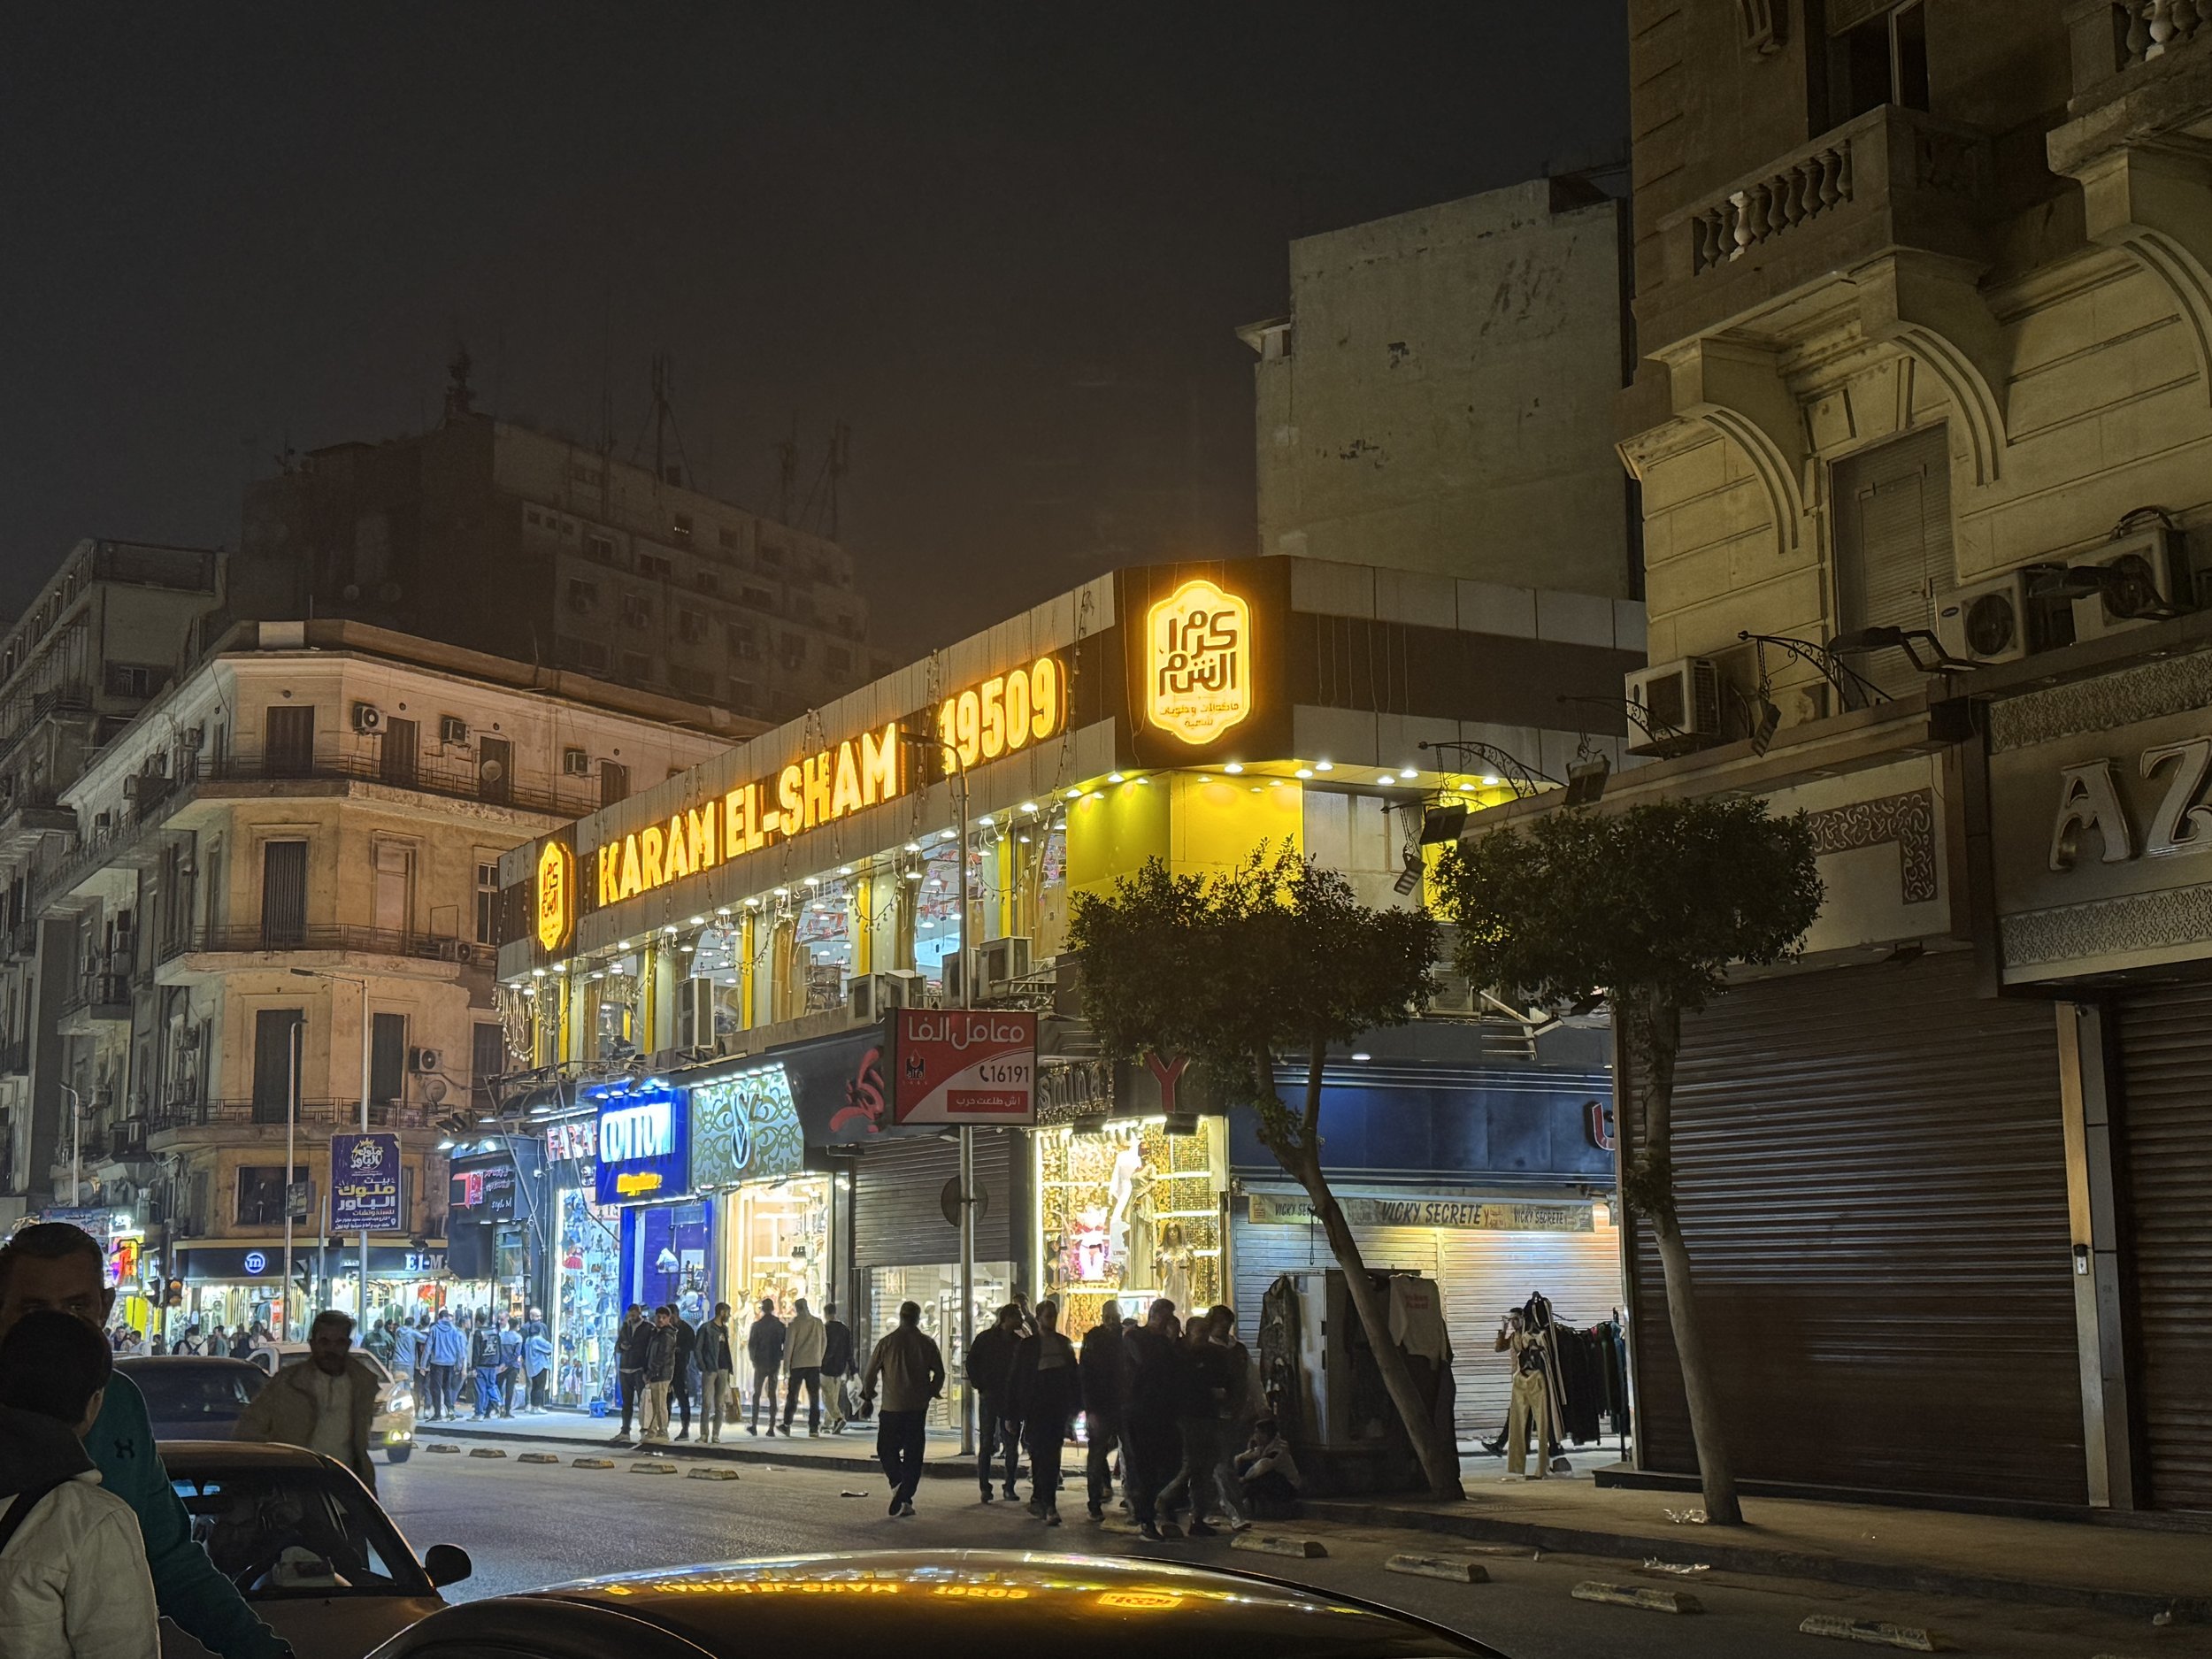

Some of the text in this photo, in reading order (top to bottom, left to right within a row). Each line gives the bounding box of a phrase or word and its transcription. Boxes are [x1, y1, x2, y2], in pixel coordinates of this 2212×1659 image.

[598, 657, 1056, 907] KARAM EL-SHAM 19509
[909, 1017, 1025, 1050] معامل الفا
[907, 1069, 924, 1079] alfa
[991, 1065, 1029, 1083] 16191
[956, 1097, 975, 1107] حرب
[977, 1096, 1003, 1105] طلعت
[547, 1120, 597, 1162] FARA
[338, 1184, 396, 1198] ملوك
[1275, 1202, 1296, 1217] VICKY
[1382, 1201, 1422, 1223] VICKY
[1425, 1203, 1483, 1225] SECRETE
[1514, 1208, 1533, 1224] VICKY
[1535, 1210, 1564, 1225] SECRETE
